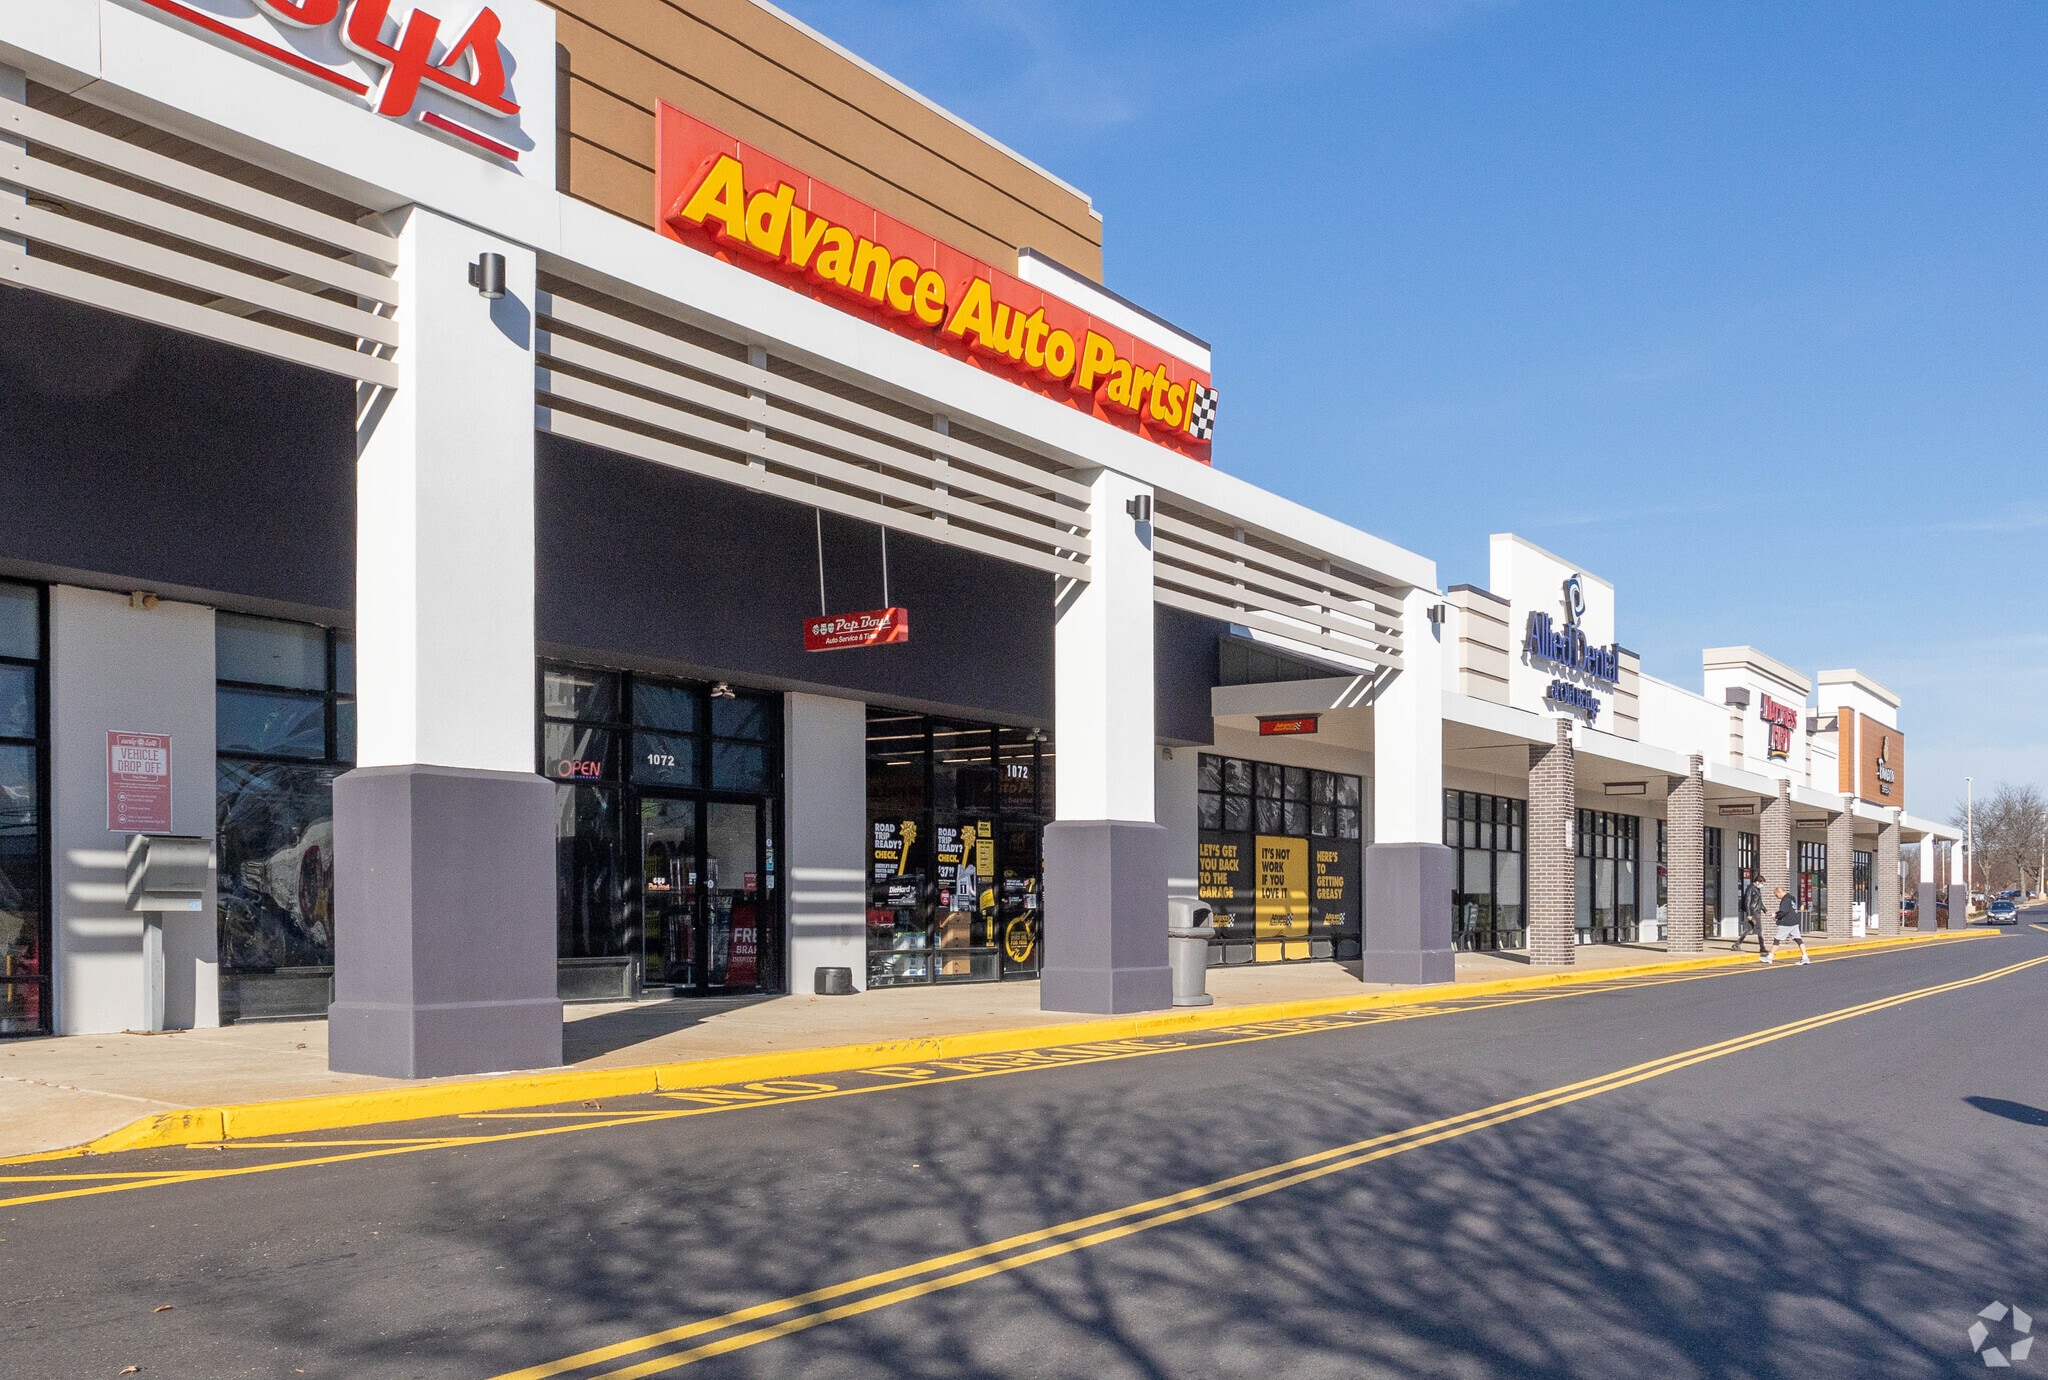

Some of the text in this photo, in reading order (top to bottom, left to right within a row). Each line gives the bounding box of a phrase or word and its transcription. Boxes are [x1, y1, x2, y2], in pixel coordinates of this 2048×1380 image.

[681, 154, 946, 324] Advance
[947, 277, 1076, 378] Auto
[836, 613, 891, 632] Pep Boys
[826, 635, 838, 644] Auto
[838, 632, 858, 643] Service
[1529, 610, 1620, 684] Allied Dental
[121, 747, 159, 761] VEHICLE
[647, 754, 675, 766] 1072
[118, 760, 162, 773] DROP OFF
[558, 760, 600, 777] OPEN
[1007, 765, 1028, 778] 1072
[875, 823, 895, 832] ROAD
[938, 828, 957, 836] ROAD
[875, 832, 890, 840] TRIP
[875, 840, 902, 849] READY?
[938, 844, 963, 853] READY?
[1200, 844, 1237, 857] LET'S GET
[875, 850, 898, 860] CHECK.
[938, 854, 959, 863] CHECK.
[1262, 848, 1290, 860] IT'S NOT
[1317, 850, 1338, 862] HERE'S
[1200, 858, 1239, 871] YOU BACK
[1262, 861, 1284, 872] WORK
[1317, 863, 1326, 874] TO
[1200, 872, 1228, 884] TO THE
[1262, 874, 1285, 885] IF YOU
[1317, 876, 1344, 887] GETTING
[1200, 886, 1234, 899] GARAGE
[1262, 888, 1287, 898] LOVE IT
[1317, 888, 1343, 899] GREASY
[653, 1081, 838, 1104] NO
[856, 1038, 1187, 1080] PARKING
